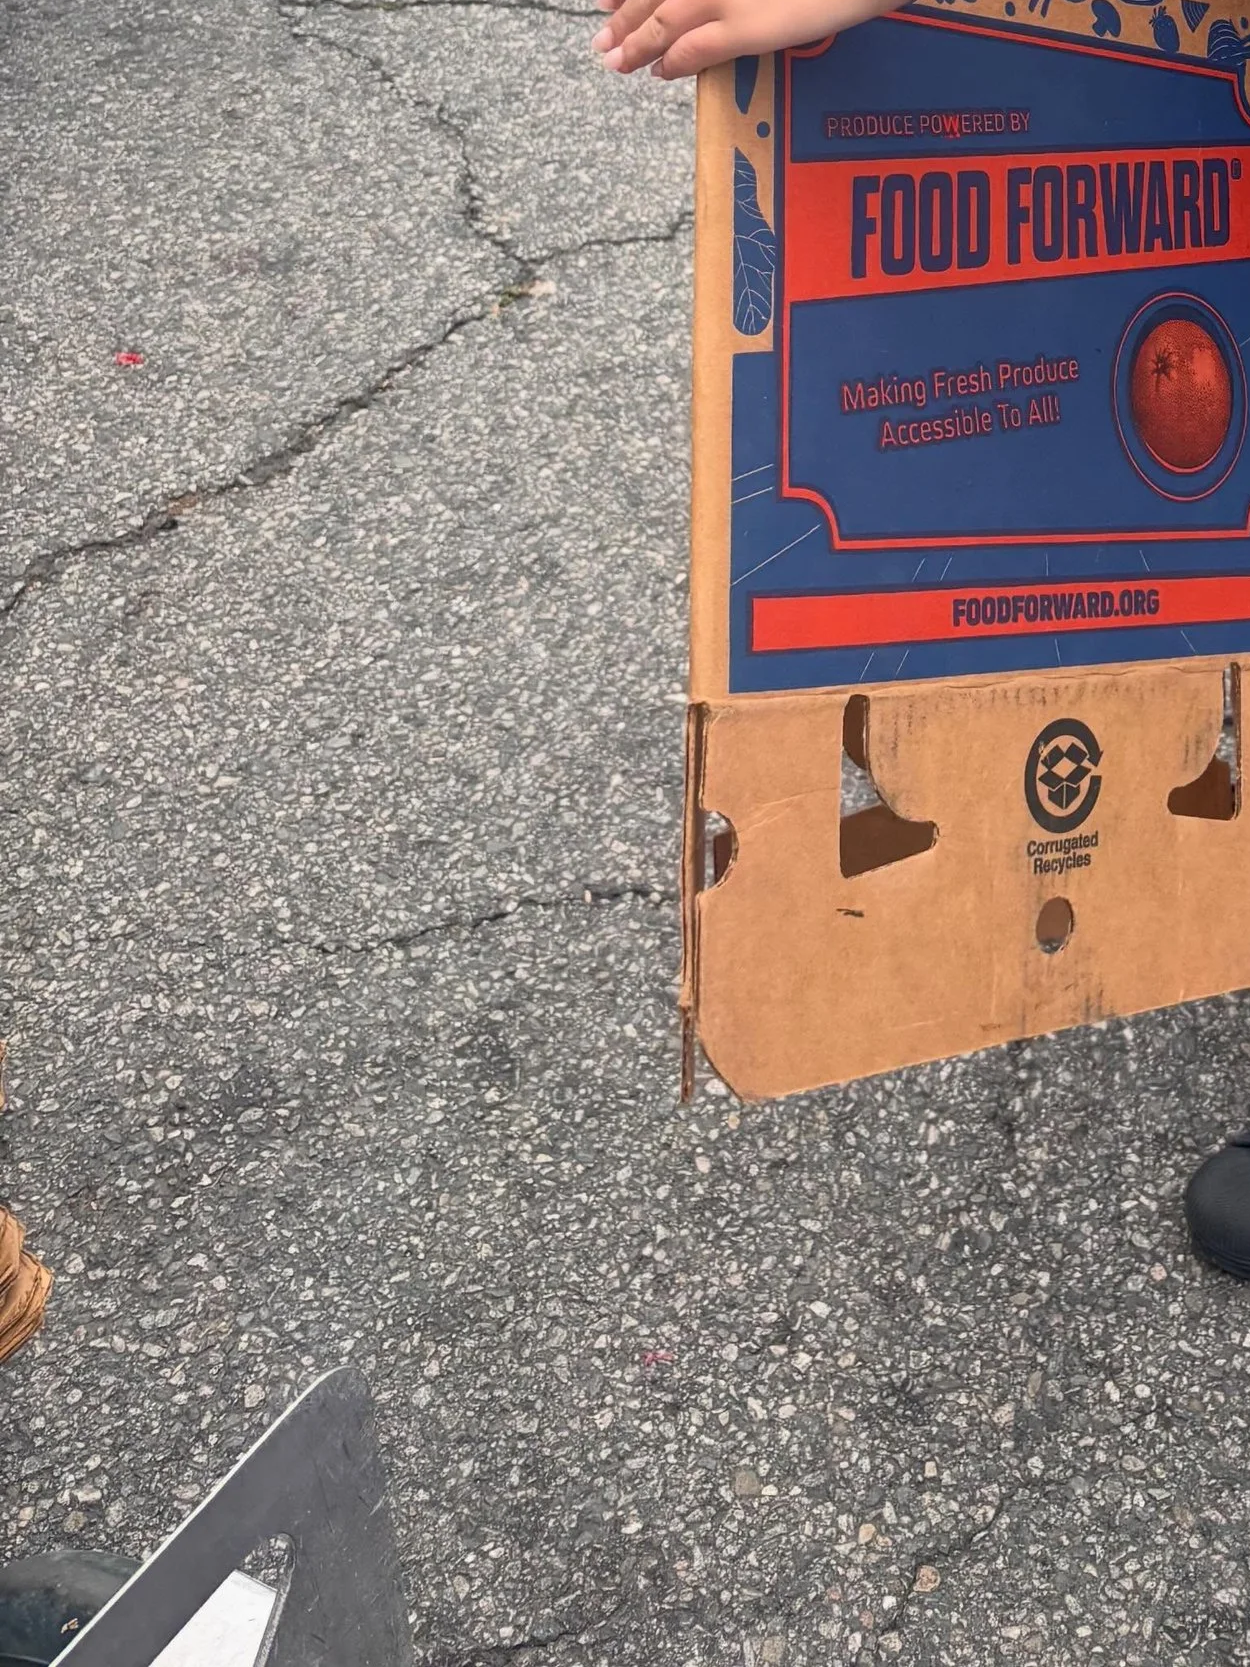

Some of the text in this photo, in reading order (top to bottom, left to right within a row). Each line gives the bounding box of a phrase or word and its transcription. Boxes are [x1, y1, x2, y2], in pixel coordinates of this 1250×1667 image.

[827, 112, 1030, 140] PRODUCE POWERED BY
[850, 170, 991, 280] FOOD
[841, 357, 1080, 412] Making Fresh Produce
[880, 394, 1061, 448] Accessible To All!
[952, 588, 1160, 628] FOODFORWARD.ORG
[1026, 831, 1099, 858] Corrugated
[1033, 852, 1092, 876] Recycles
